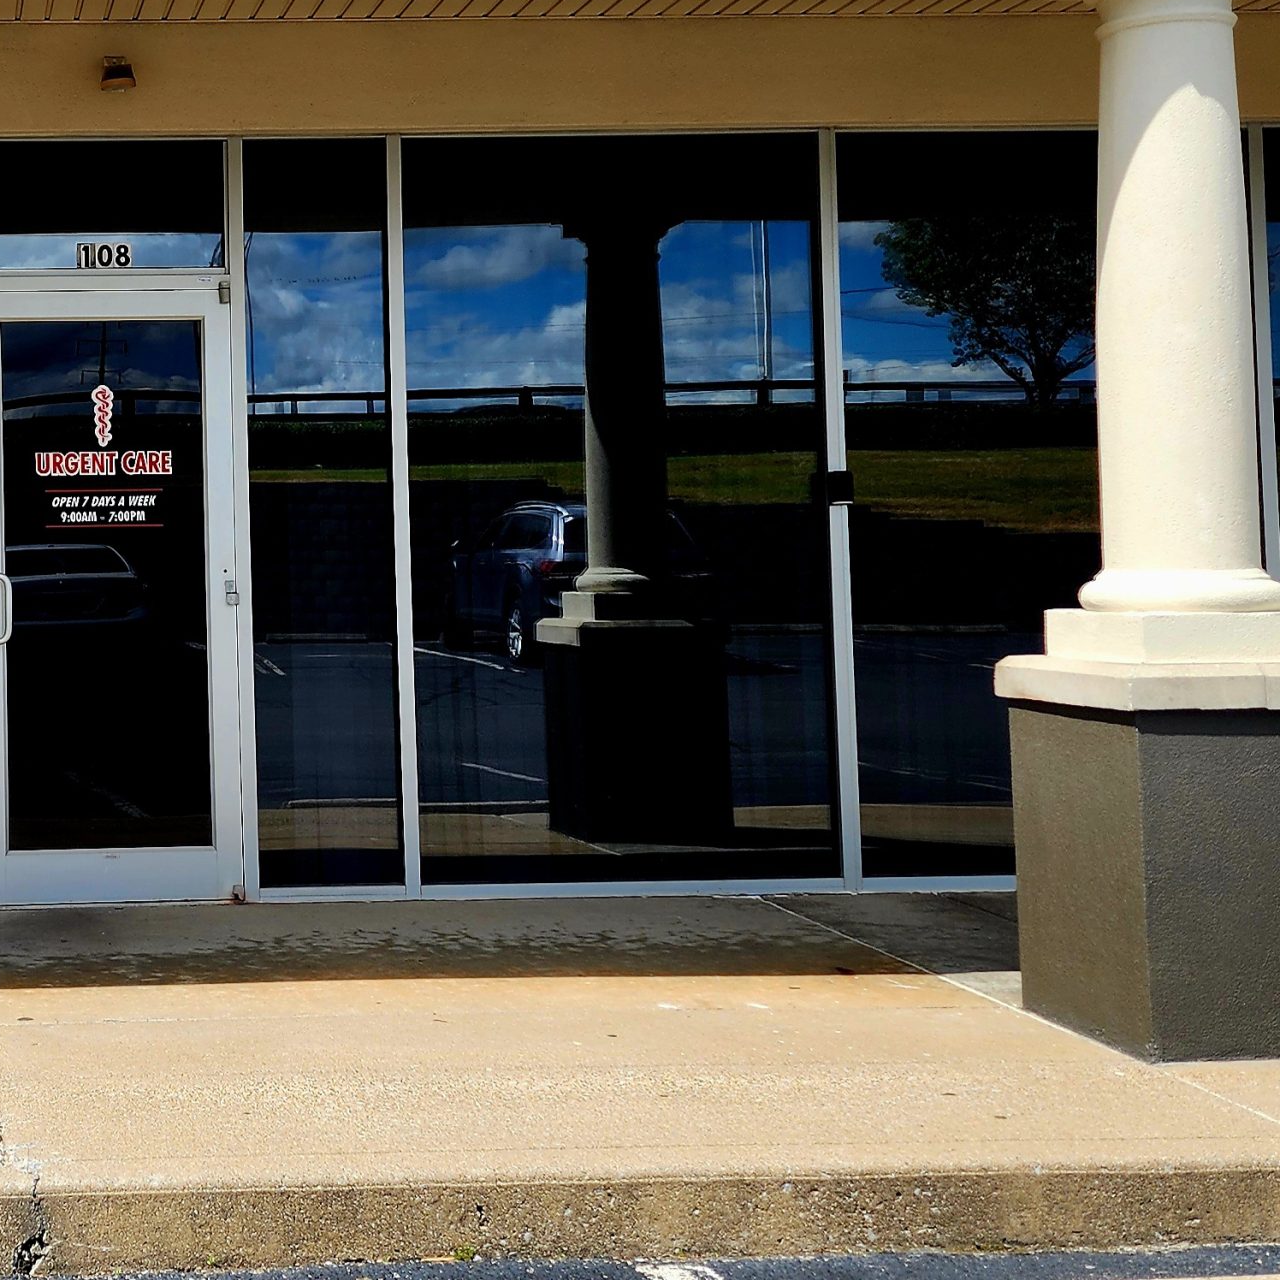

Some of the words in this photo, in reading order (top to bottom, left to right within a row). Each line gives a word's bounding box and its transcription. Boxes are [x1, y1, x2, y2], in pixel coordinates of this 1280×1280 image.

[81, 244, 131, 268] 108
[35, 451, 118, 476] URGENT
[122, 451, 173, 475] CARE
[51, 495, 81, 508] OPEN
[81, 495, 90, 507] 7
[91, 495, 116, 508] DAYS
[117, 495, 125, 507] A
[128, 495, 156, 507] WEEK
[60, 511, 98, 523] 9:00AM
[108, 510, 146, 522] 7:00PM
